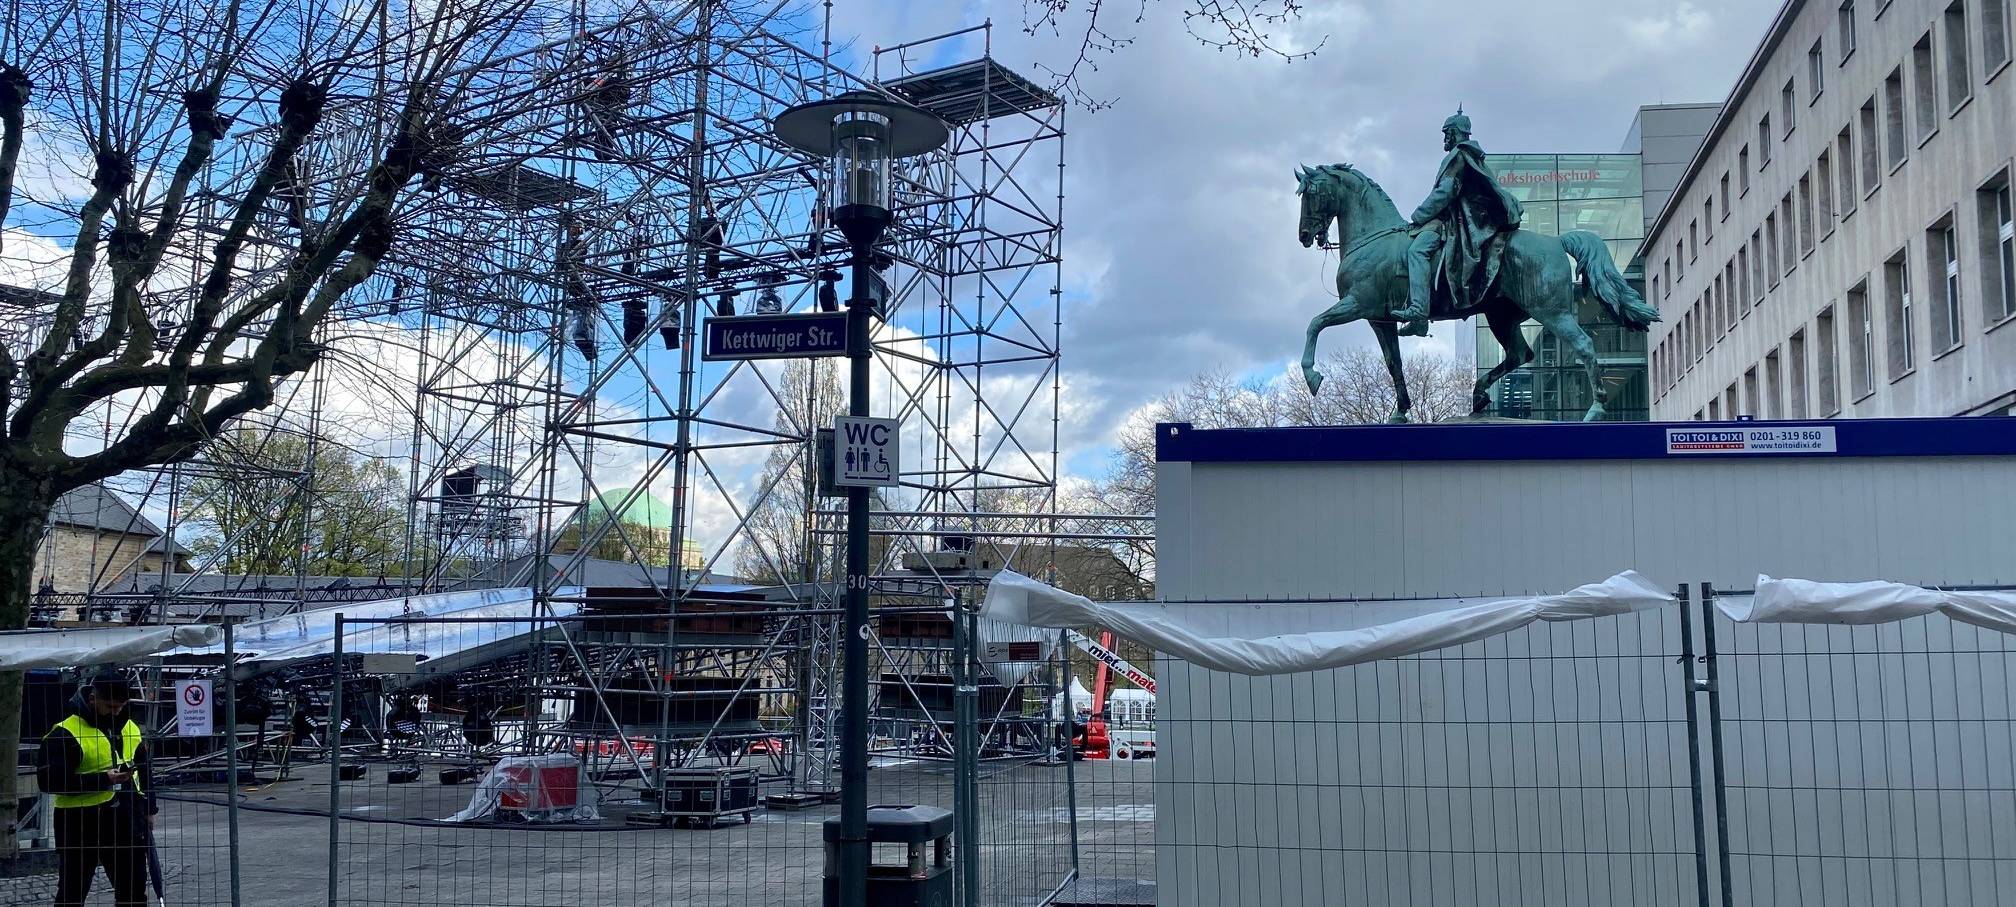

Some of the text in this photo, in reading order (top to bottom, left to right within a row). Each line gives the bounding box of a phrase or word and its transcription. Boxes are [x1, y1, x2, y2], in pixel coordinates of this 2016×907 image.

[1496, 169, 1600, 185] olkshochschule
[722, 326, 838, 351] Kettwiger Str.
[845, 423, 890, 446] WC
[1672, 433, 1743, 442] TOI TOI & DIXI
[1750, 432, 1774, 441] 0201
[1781, 431, 1800, 440] 319
[1802, 431, 1821, 440] 860
[848, 574, 867, 590] 30
